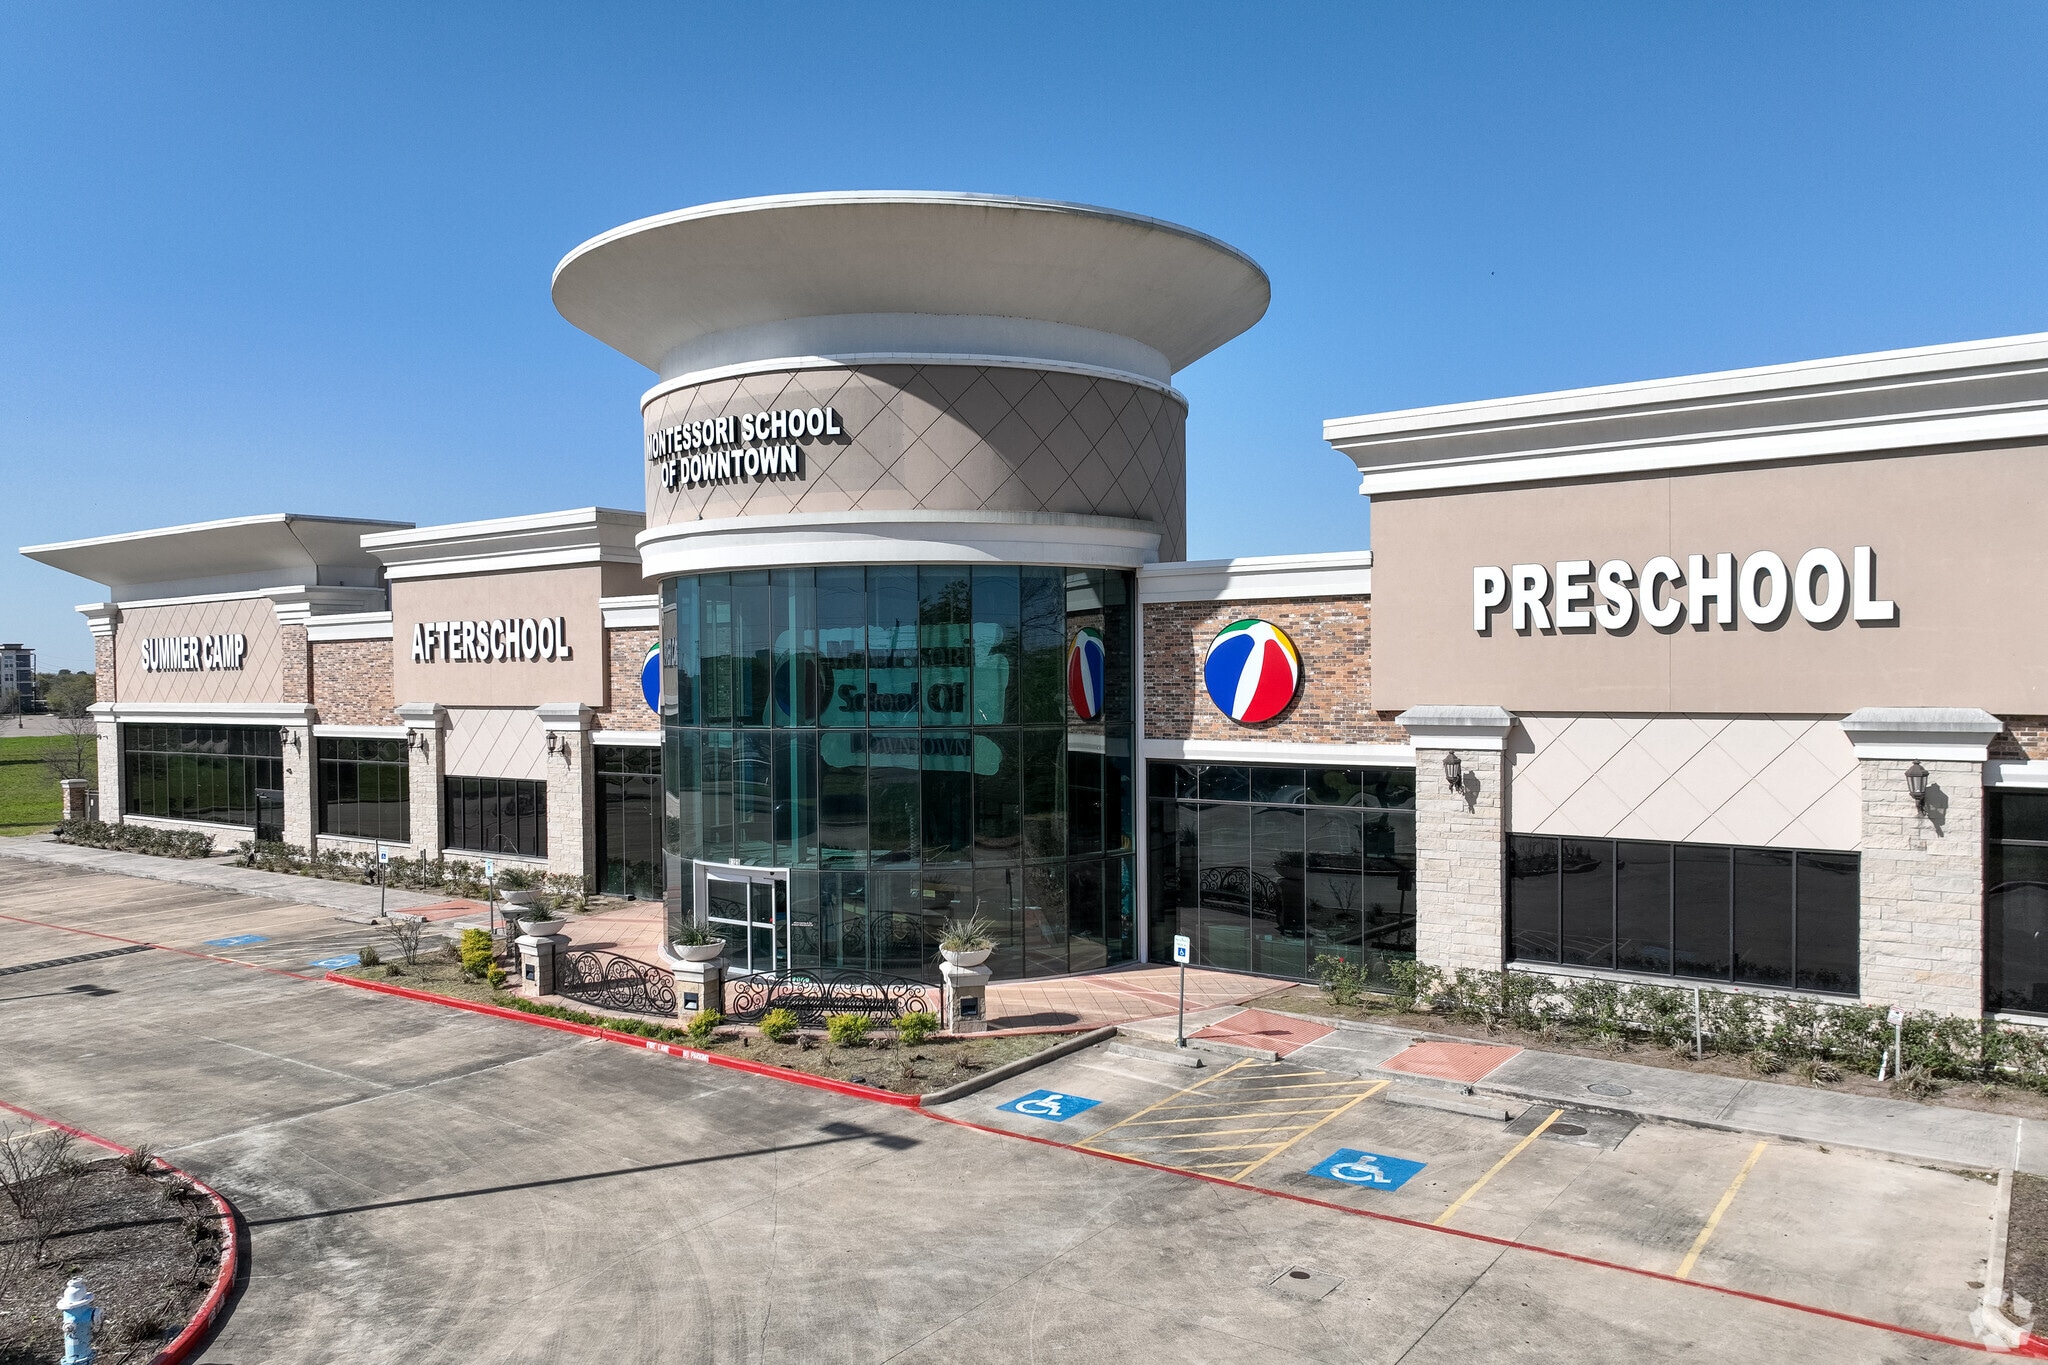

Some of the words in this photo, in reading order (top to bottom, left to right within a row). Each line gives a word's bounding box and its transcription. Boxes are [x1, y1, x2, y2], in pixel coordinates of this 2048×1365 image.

[647, 415, 736, 460] MONTESSORI
[742, 407, 842, 441] SCHOOL
[661, 459, 677, 488] OF
[681, 445, 798, 483] DOWNTOWN
[1473, 545, 1897, 634] PRESCHOOL
[142, 636, 201, 670] SUMMER
[203, 634, 245, 669] CAMP
[411, 616, 570, 661] AFTERSCHOOL
